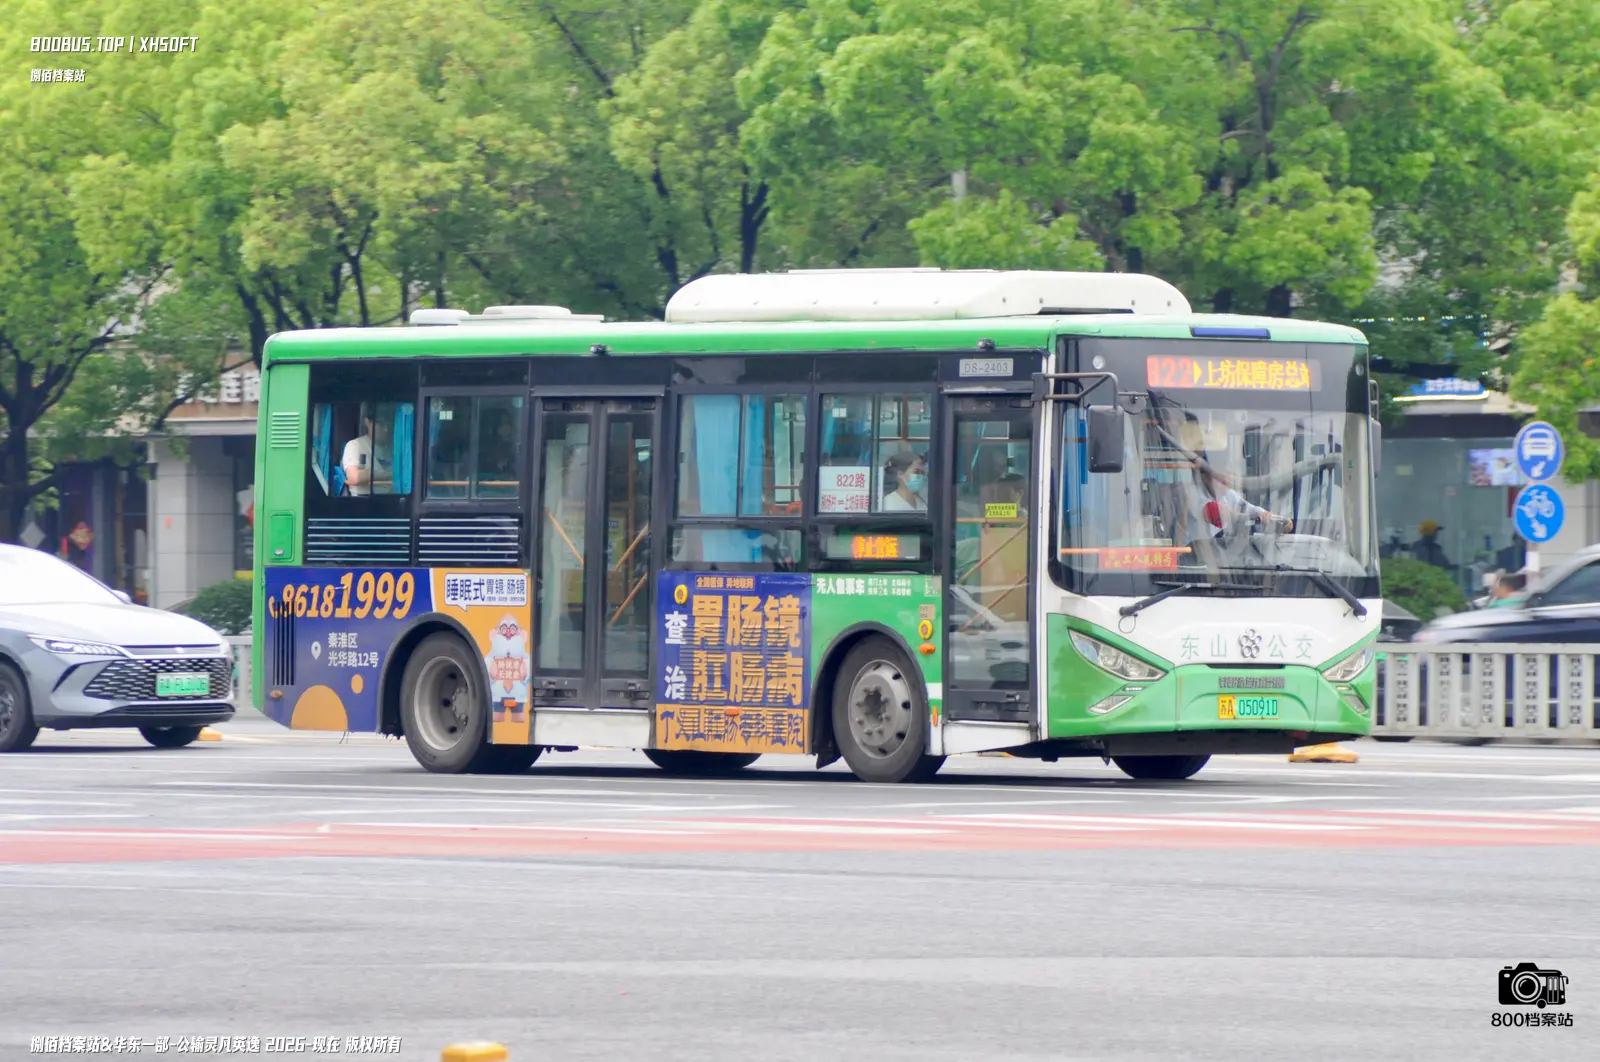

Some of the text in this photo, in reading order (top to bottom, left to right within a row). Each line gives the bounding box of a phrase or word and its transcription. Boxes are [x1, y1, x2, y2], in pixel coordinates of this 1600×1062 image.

[964, 362, 1008, 373] DS-2403
[1147, 355, 1194, 387] 822
[836, 473, 865, 489] 822路
[447, 578, 485, 601] 睡眠式
[507, 578, 525, 595] 肠镜
[665, 610, 688, 645] 查
[692, 594, 802, 648] 胃肠镜
[328, 632, 358, 649] 秦淮区
[328, 651, 379, 668] 光华路12号
[665, 665, 688, 700] 治
